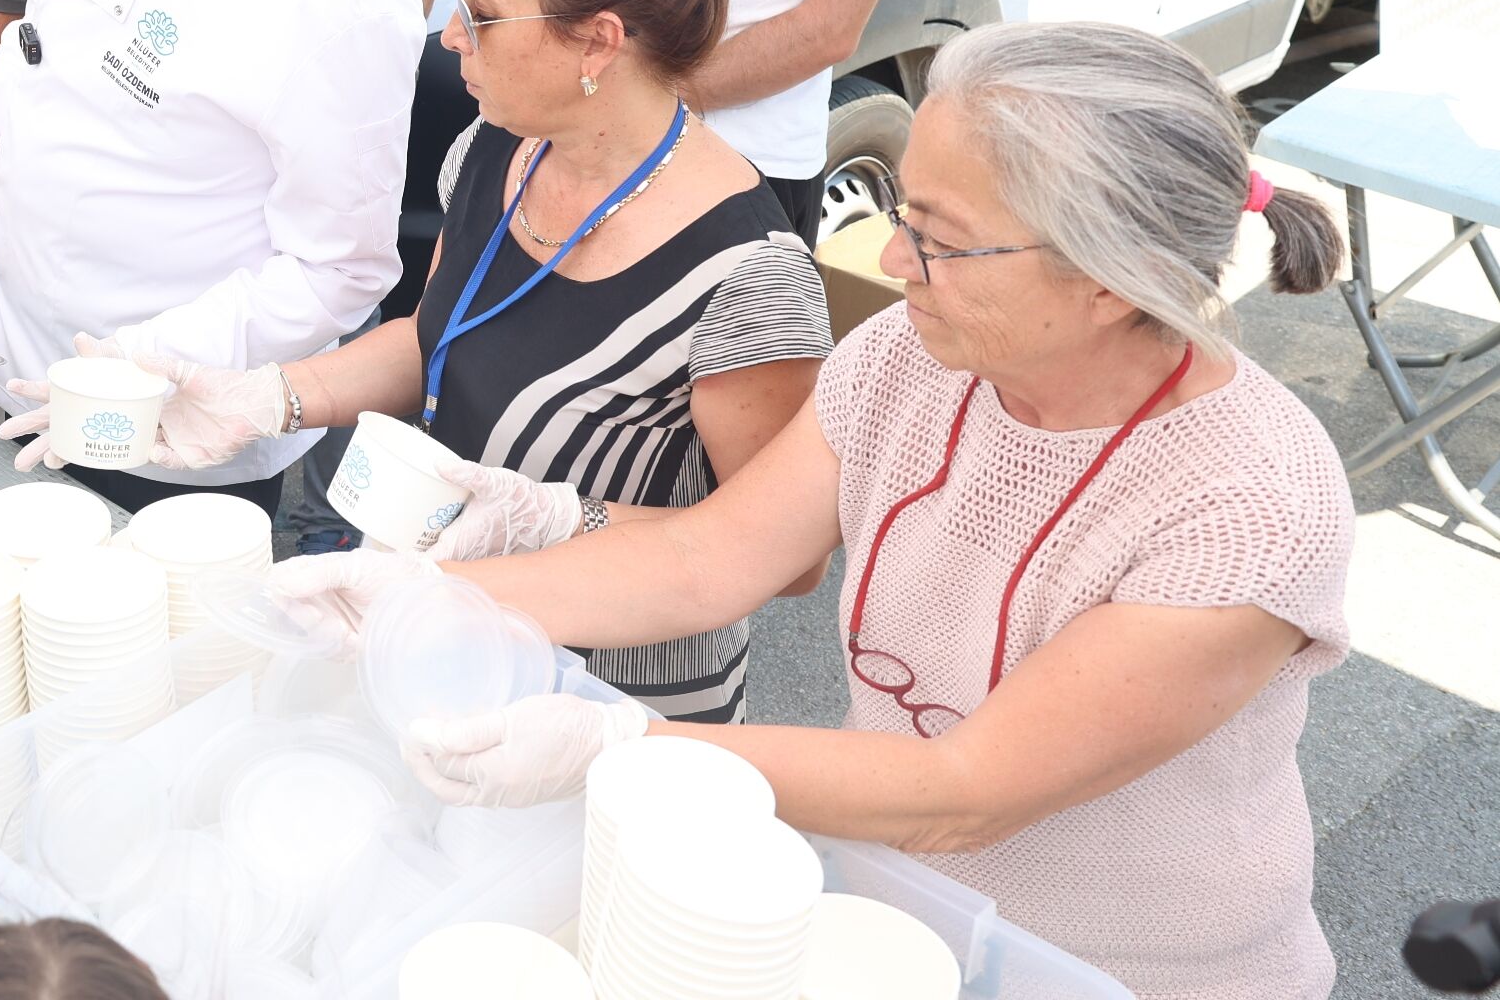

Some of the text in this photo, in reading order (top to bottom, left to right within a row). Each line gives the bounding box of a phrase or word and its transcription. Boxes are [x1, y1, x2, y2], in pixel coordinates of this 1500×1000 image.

[131, 37, 162, 68] NİLÜFER
[103, 50, 161, 104] ŞADİ ÖZDEMİR
[84, 450, 130, 459] BELEDİYESİ
[85, 441, 131, 452] NİLÜFER
